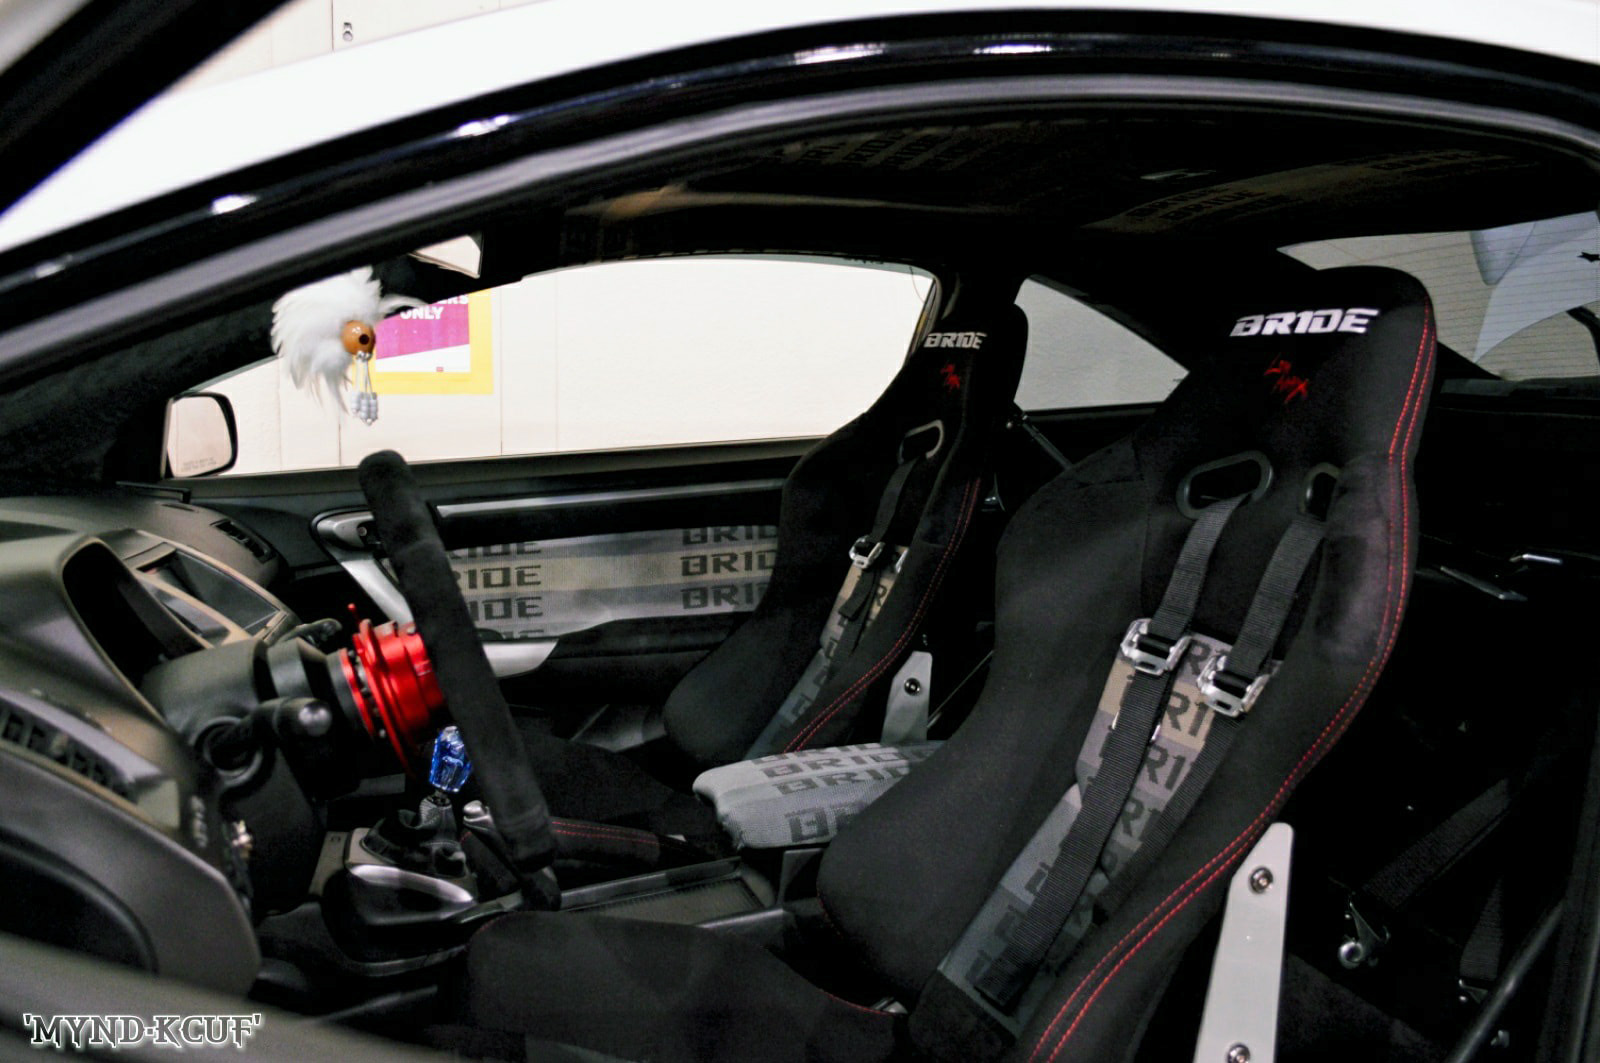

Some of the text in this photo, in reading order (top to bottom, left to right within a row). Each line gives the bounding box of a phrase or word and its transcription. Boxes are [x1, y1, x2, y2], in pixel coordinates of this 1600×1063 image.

[400, 305, 445, 320] ONLY
[1229, 307, 1379, 337] BRIDE
[923, 332, 988, 350] BRIDE
[680, 549, 777, 576] BRID
[452, 565, 542, 590] IDE
[468, 596, 543, 622] IDE
[680, 582, 770, 610] BRI
